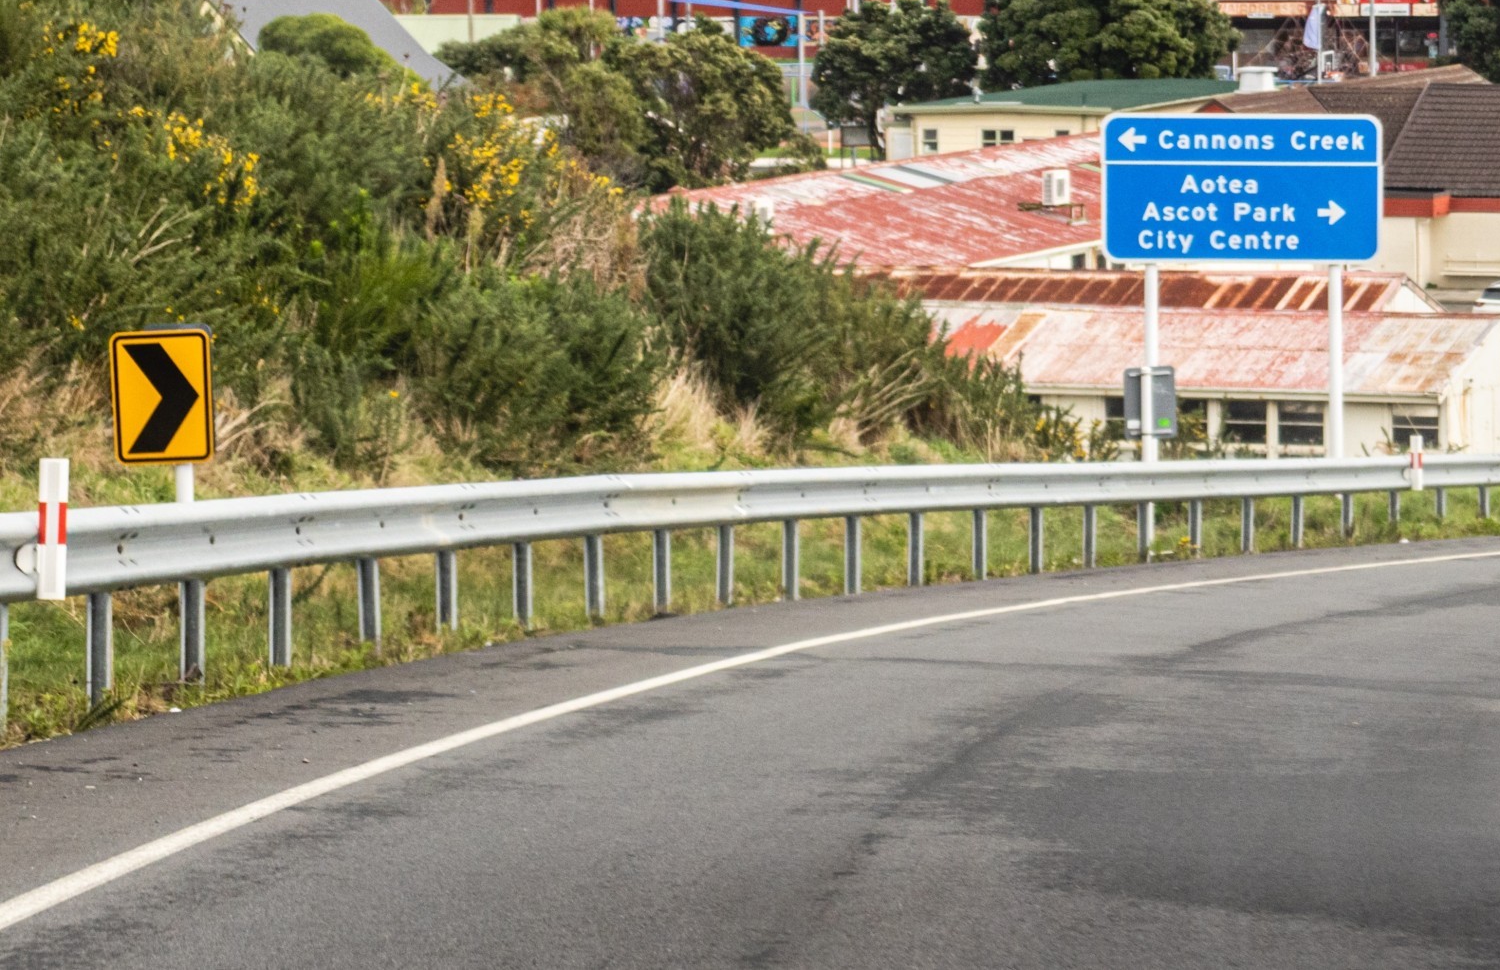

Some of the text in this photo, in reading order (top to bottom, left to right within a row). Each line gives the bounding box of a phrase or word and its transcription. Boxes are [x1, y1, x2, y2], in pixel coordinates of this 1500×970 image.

[1158, 129, 1365, 151] Cannons Creek
[1180, 174, 1259, 195] Aotea
[1142, 201, 1296, 222] Ascot Park
[1138, 229, 1300, 254] City Centre
